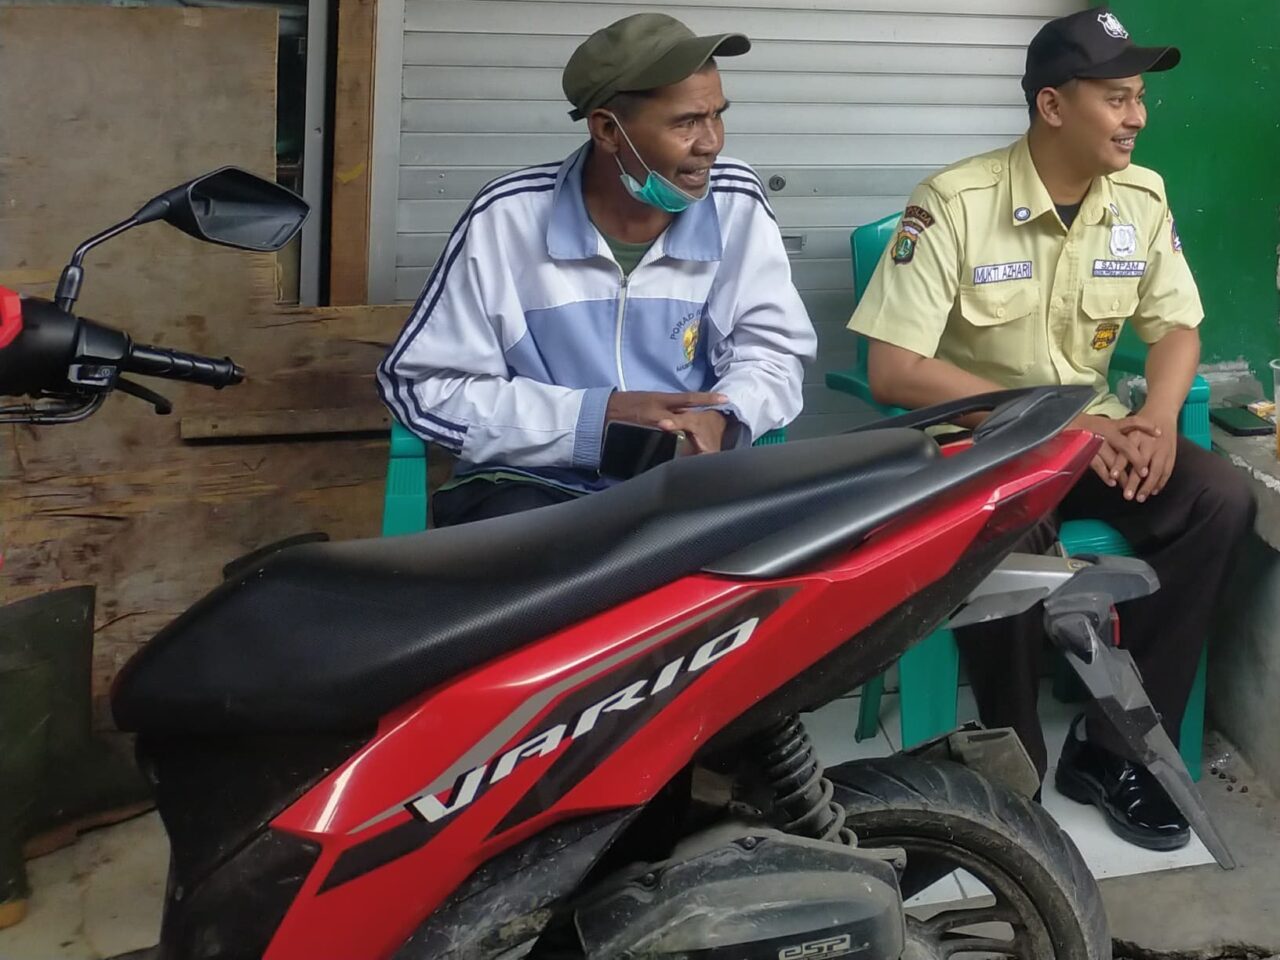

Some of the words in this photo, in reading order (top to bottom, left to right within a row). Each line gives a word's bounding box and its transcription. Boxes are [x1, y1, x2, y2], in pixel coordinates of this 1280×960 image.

[1002, 263, 1032, 279] AZHARI
[1101, 261, 1140, 270] SATPAM
[406, 616, 759, 824] VARIO
